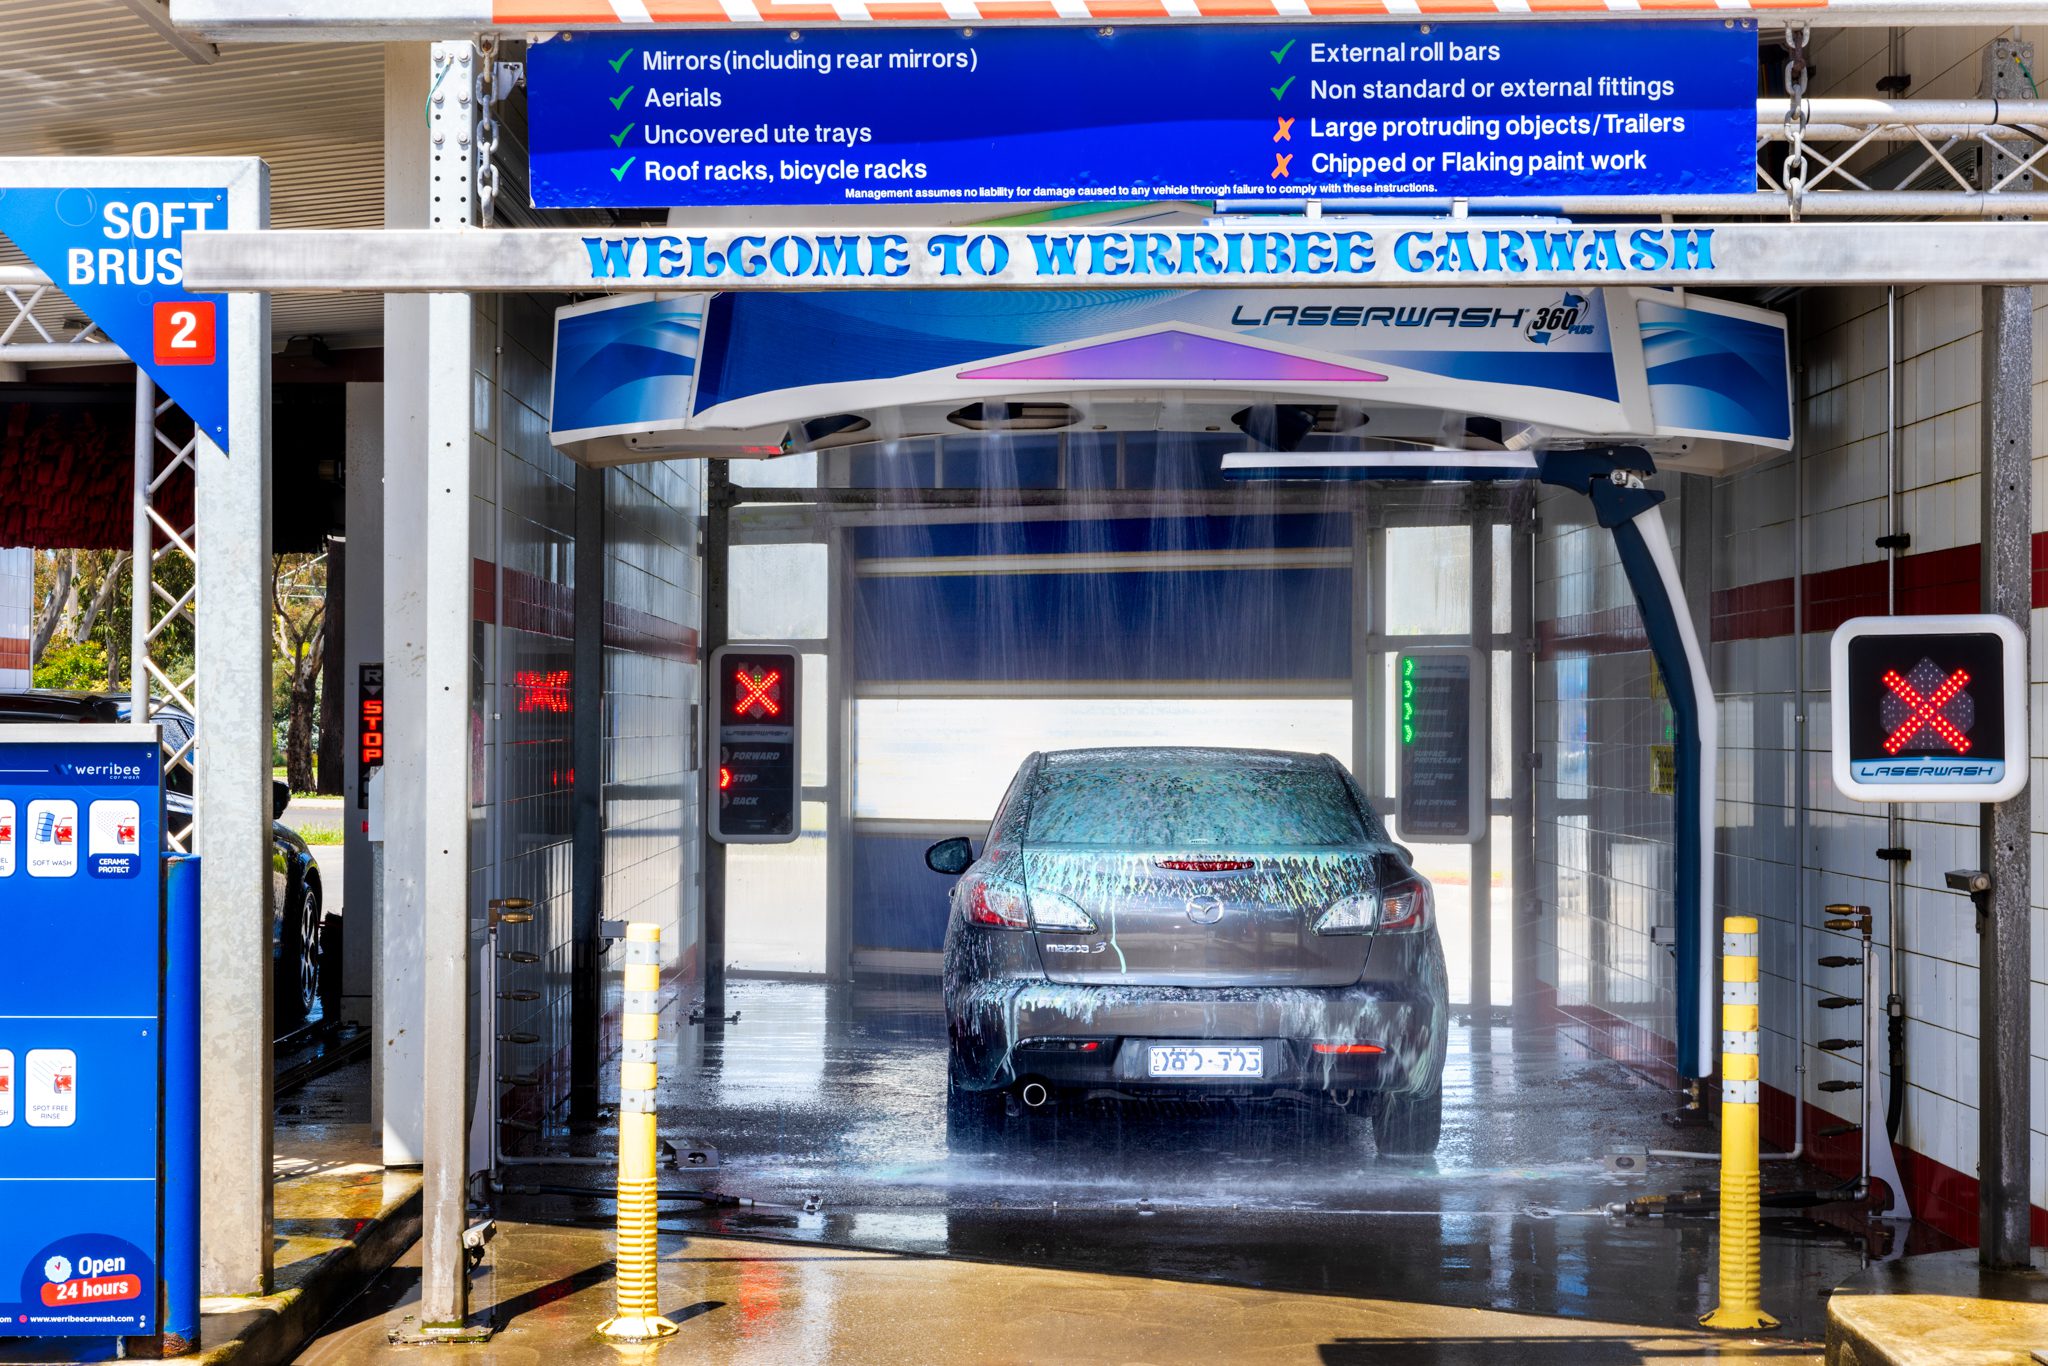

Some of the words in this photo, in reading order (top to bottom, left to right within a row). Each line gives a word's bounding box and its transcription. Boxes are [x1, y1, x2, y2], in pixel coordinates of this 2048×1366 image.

[643, 49, 831, 75] Mirrors(including
[836, 53, 883, 69] rear
[889, 48, 978, 73] mirrors)
[1311, 42, 1405, 63] External
[1410, 41, 1444, 62] roll
[1449, 41, 1501, 62] bars
[644, 87, 722, 108] Aerials
[1311, 79, 1356, 100] Non
[1362, 78, 1465, 99] standard
[1471, 82, 1495, 98] or
[1500, 76, 1592, 98] external
[1597, 76, 1675, 101] fittings
[644, 123, 768, 145] Uncovered
[774, 124, 810, 143] ute
[814, 124, 872, 148] trays
[1311, 117, 1377, 142] Large
[1382, 115, 1500, 142] protruding
[1505, 113, 1685, 140] objects/Trailers
[645, 160, 700, 181] Roof
[704, 160, 774, 184] racks,
[780, 159, 860, 185] bicycle
[864, 158, 927, 179] racks
[1311, 152, 1406, 178] Chipped
[1412, 156, 1436, 173] or
[1442, 151, 1523, 177] Flaking
[1528, 150, 1585, 176] paint
[1590, 149, 1647, 170] work
[845, 187, 913, 200] Management
[915, 188, 962, 198] assumes
[964, 187, 978, 197] no
[979, 186, 1014, 198] liability
[1016, 186, 1031, 197] for
[1033, 185, 1076, 199] damage
[1078, 185, 1117, 196] caused
[1118, 186, 1129, 195] to
[1131, 186, 1150, 197] any
[1153, 185, 1189, 195] vehicle
[1190, 184, 1231, 197] through
[1233, 184, 1265, 195] failure
[1266, 184, 1277, 195] to
[1279, 184, 1317, 196] comply
[1320, 183, 1341, 194] with
[1343, 183, 1372, 194] these
[1374, 182, 1438, 194] instructions.
[102, 201, 214, 240] SOFT
[581, 235, 911, 280] WELCOME
[927, 233, 1011, 279] TO
[1026, 231, 1376, 278] WERRIBEE
[1394, 227, 1717, 276] CARWASH
[1231, 305, 1525, 329] LASERWASH
[1531, 307, 1579, 331] 360
[170, 311, 197, 349] 2
[363, 699, 383, 763] STOP
[732, 751, 780, 760] FORWARD
[75, 762, 140, 775] werribee
[732, 774, 758, 783] STOP
[1860, 766, 1993, 777] LASERWASH
[732, 796, 759, 806] BACK
[32, 859, 50, 867] SOFT
[98, 858, 130, 866] CERAMIC
[98, 866, 130, 874] PROTECT
[1091, 941, 1107, 954] 3
[78, 1256, 126, 1279] Open
[56, 1282, 79, 1300] 24
[82, 1280, 129, 1298] hours
[30, 1315, 135, 1323] www.werribeecarwash.com
